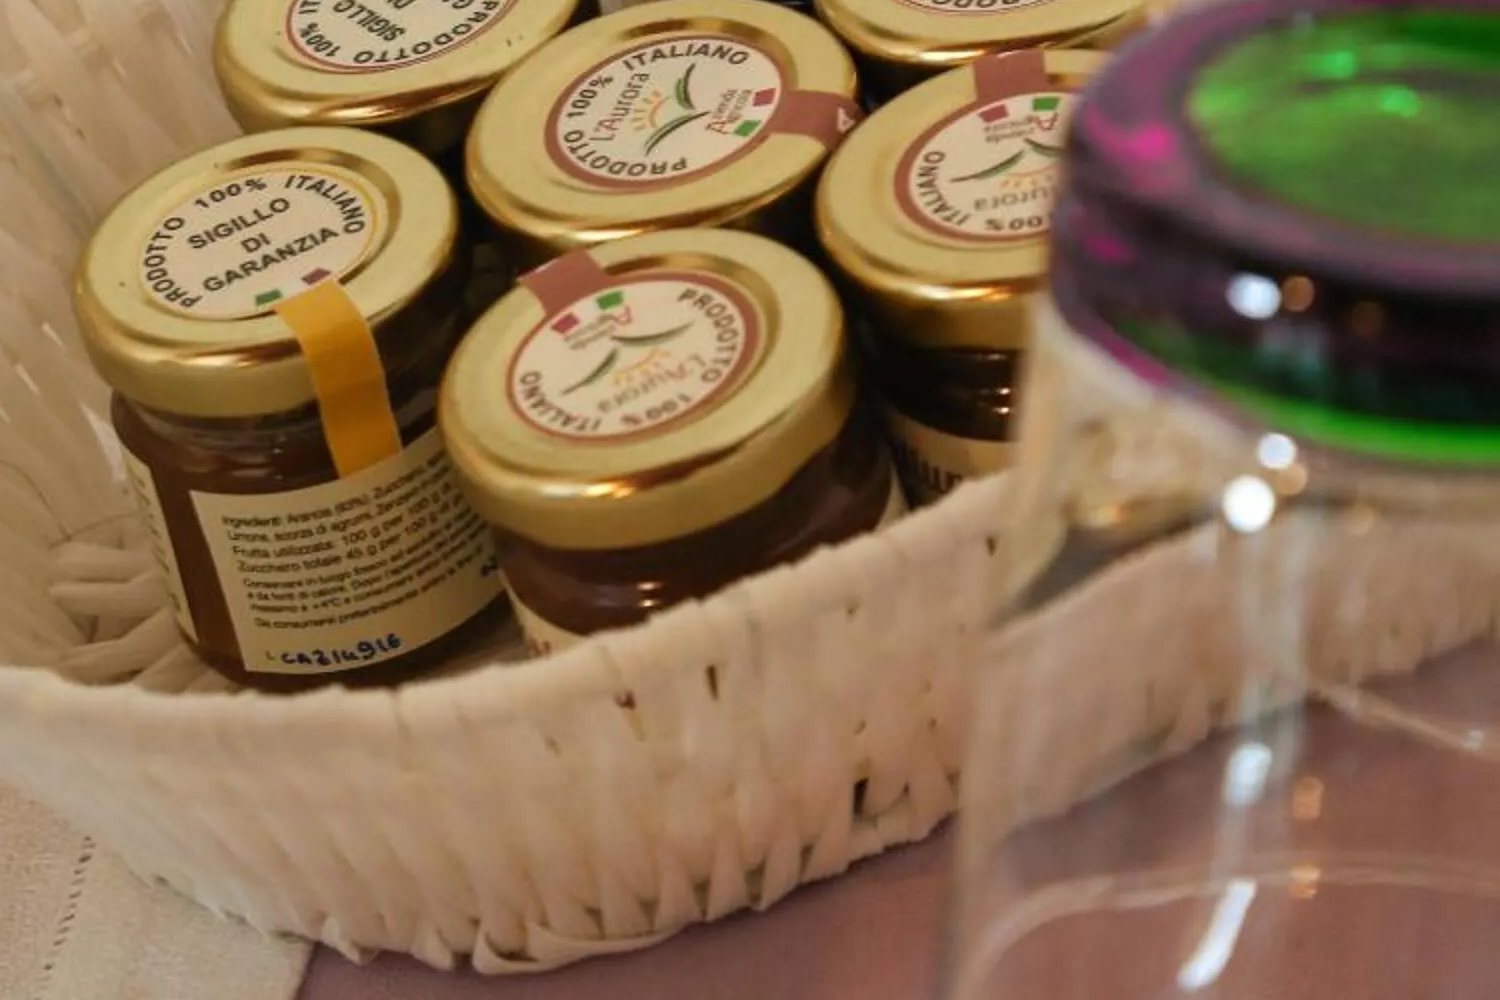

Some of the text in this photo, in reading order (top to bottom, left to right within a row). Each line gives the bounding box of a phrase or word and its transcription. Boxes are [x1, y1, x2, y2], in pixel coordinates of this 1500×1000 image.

[299, 22, 341, 57] 100%
[333, 0, 406, 42] SIGILLO
[354, 0, 499, 63] PRODOTTO
[564, 43, 749, 176] PRODOTTO 100% ITALIANO
[916, 151, 971, 226] ITALIANO
[144, 174, 365, 308] PRODOTTO 100% ITALIANO
[187, 197, 290, 250] SIGILLO
[240, 232, 272, 254] DI
[203, 227, 339, 292] GARANZIA
[677, 288, 739, 382] PRODOTTO
[519, 371, 602, 431] ITALIANO
